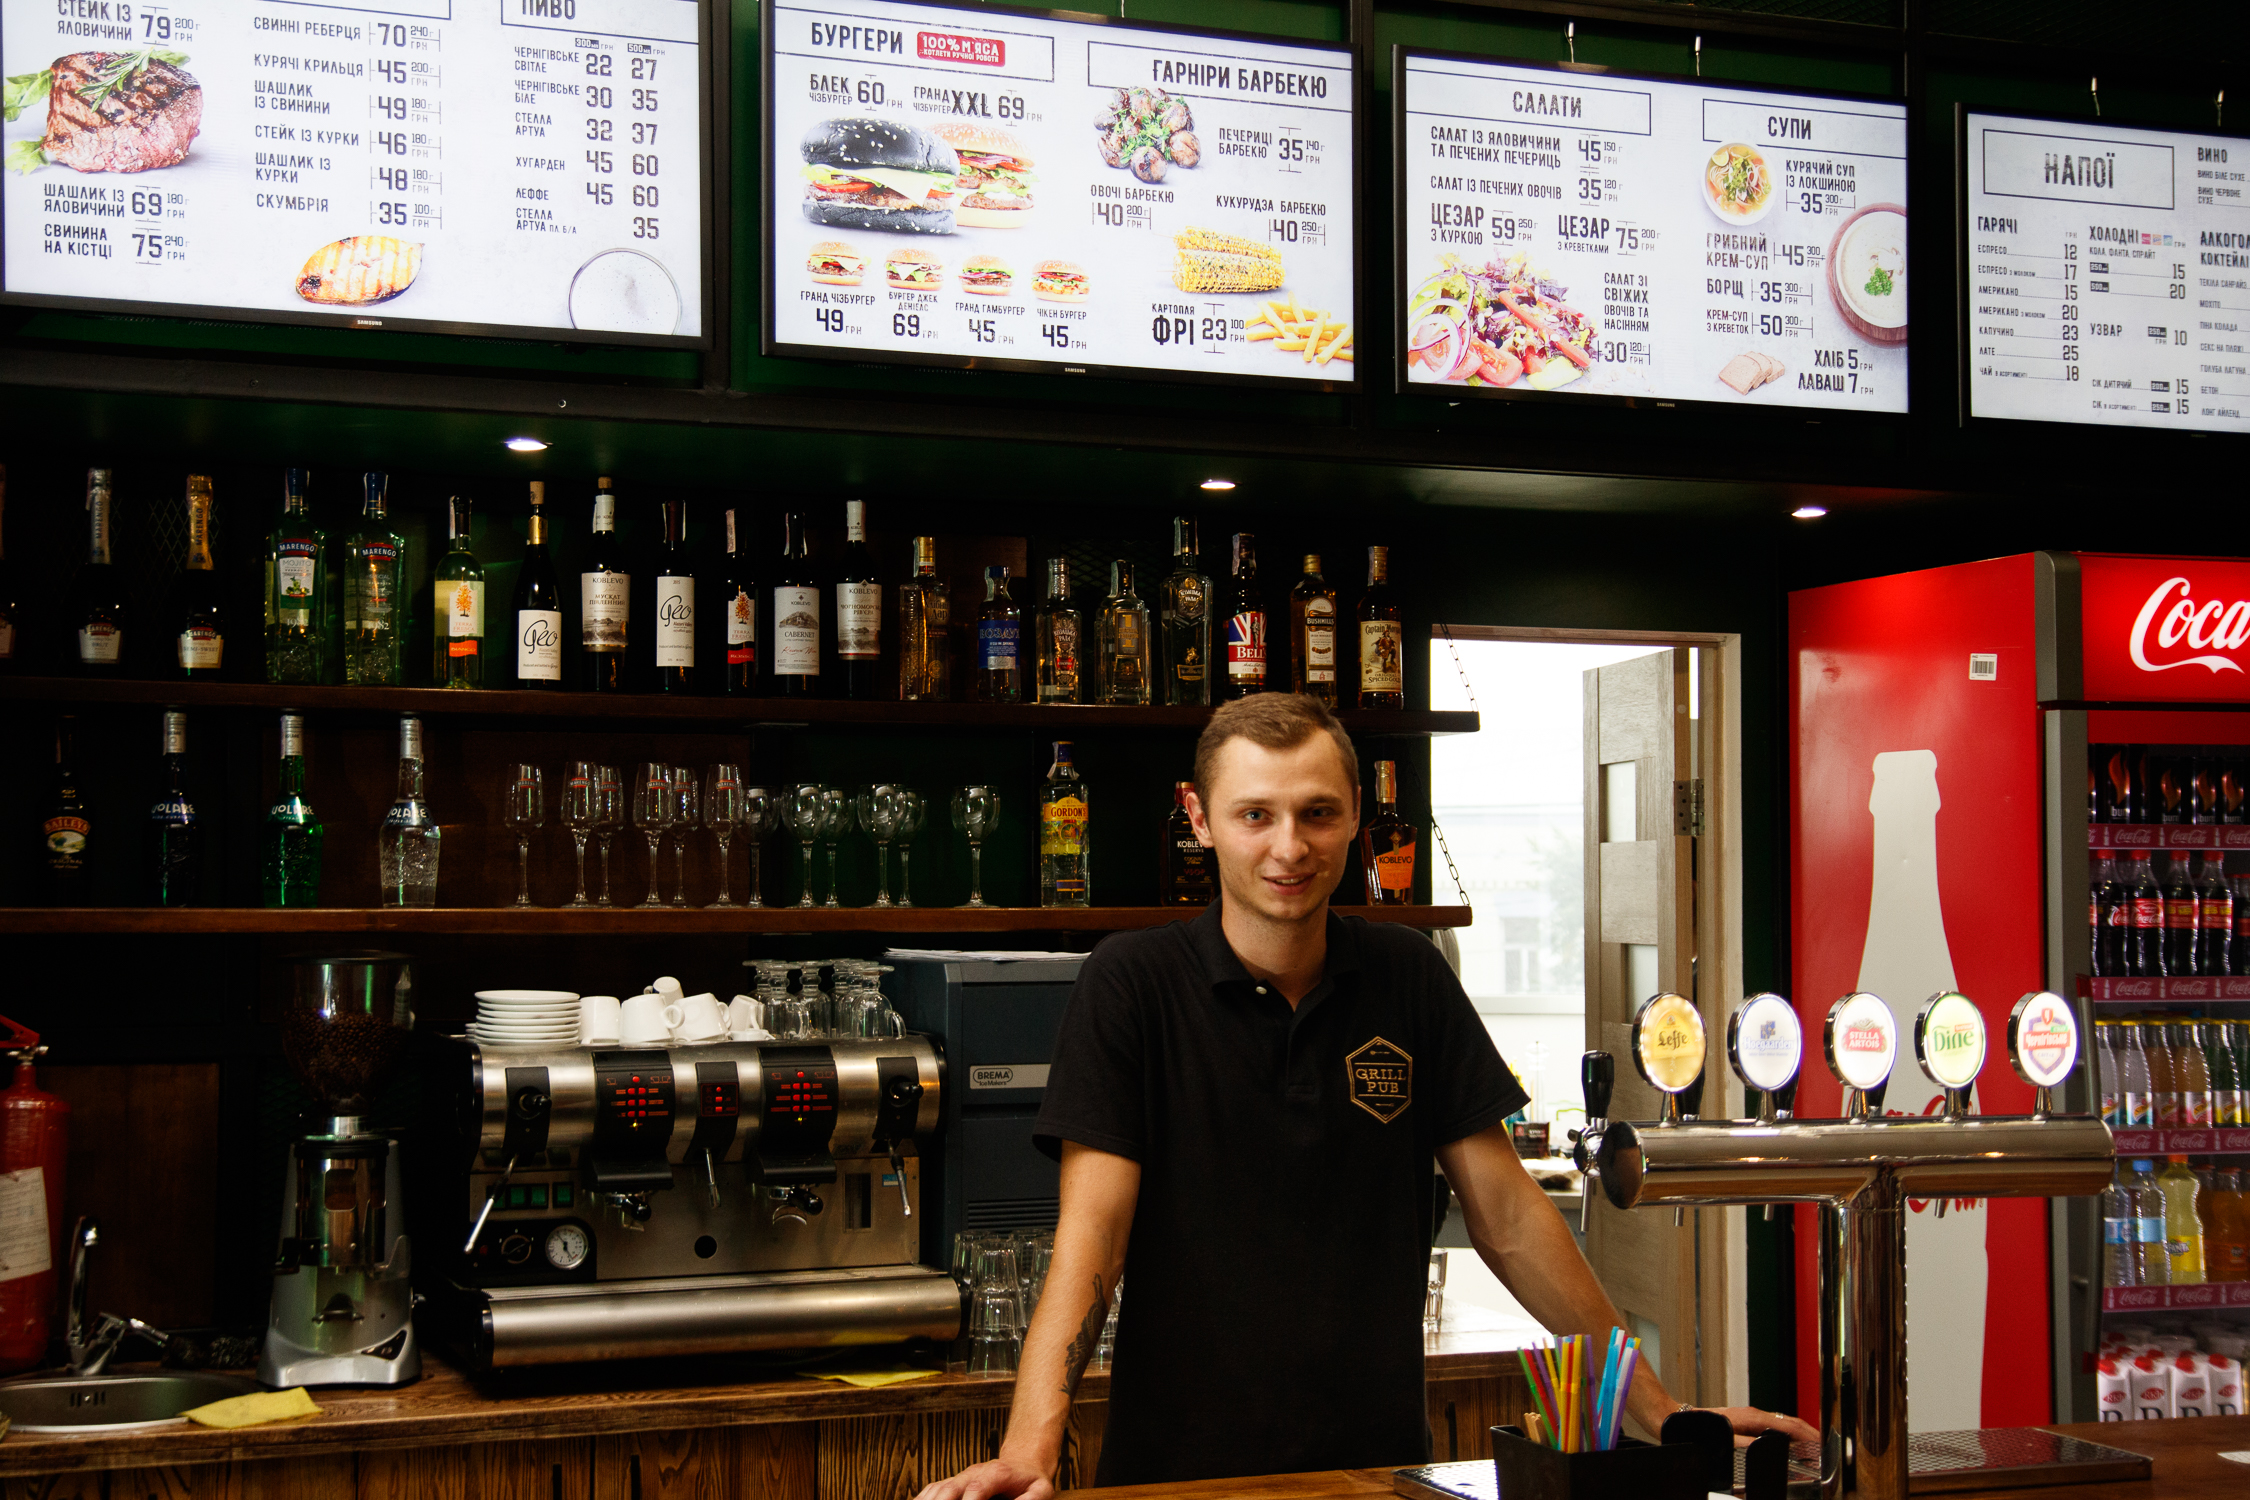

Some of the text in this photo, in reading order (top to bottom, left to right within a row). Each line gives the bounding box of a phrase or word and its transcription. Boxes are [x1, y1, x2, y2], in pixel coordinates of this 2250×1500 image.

[116, 3, 131, 22] ІЗ
[58, 20, 132, 41] ЯЛОВИЧИНИ
[140, 14, 171, 39] 79
[254, 17, 361, 40] СВИННІ РЕБЕРЦЯ
[378, 23, 406, 47] 70
[175, 32, 193, 42] ГРН
[810, 22, 903, 55] БУРГЕРИ
[922, 35, 960, 52] 100%
[514, 46, 580, 63] ЧЕРНІГІВСЬКЕ
[254, 54, 364, 78] КУРЯЧІ КРИЛЬЦЯ
[378, 60, 406, 84] 45
[514, 60, 547, 73] СВІТЛЕ
[810, 74, 850, 95] БЛЕК
[1152, 59, 1328, 98] ГАРНІРИ БАРБЕКЮ
[858, 80, 885, 105] 60
[914, 86, 950, 104] ГРАНД
[998, 96, 1024, 120] 69
[1512, 91, 1582, 118] САЛАТИ
[255, 124, 359, 146] СТЕЙК ІЗ КУРКИ
[1218, 127, 1272, 146] ПЕЧЕРИЦІ
[1768, 116, 1812, 140] СУПИ
[1430, 126, 1561, 152] САЛАТ ІЗ ЯЛОВИЧИНИ
[1218, 142, 1267, 158] БАРБЕКЮ
[1278, 138, 1303, 162] 35
[1431, 143, 1561, 170] ТА ПЕЧЕНИХ ПЕЧЕРИЦЬ
[1578, 139, 1601, 162] 45
[2198, 147, 2228, 164] ВИНО
[516, 156, 566, 172] ХУГАРДЕН
[1786, 160, 1855, 178] КУРЯЧИЙ СУП
[2044, 152, 2116, 189] НАПОЇ
[44, 183, 125, 202] ШАШЛИК ІЗ
[1430, 175, 1562, 200] САЛАТ ІЗ ПЕЧЕНИХ ОВОЧІВ
[1578, 178, 1602, 200] 35
[1786, 175, 1856, 193] ІЗ ЛОКШИНОЮ
[256, 194, 328, 213] СКУМБРІЯ
[516, 188, 550, 201] ЛЕФФЕ
[1090, 184, 1174, 204] ОВОЧІ БАРБЕКЮ
[44, 199, 125, 218] ЯЛОВИЧИНИ
[132, 192, 162, 216] 69
[1216, 194, 1326, 216] КУКУРУДЗА БАРБЕКЮ
[1098, 202, 1124, 226] 40
[1432, 202, 1484, 228] ЦЕЗАР
[44, 224, 108, 241] СВИНИНА
[1274, 219, 1298, 243] 40
[1492, 218, 1515, 239] 59
[1558, 214, 1610, 240] ЦЕЗАР
[1978, 216, 2018, 234] ГАРЯЧІ
[1430, 228, 1483, 245] З КУРКОЮ
[1616, 227, 1638, 250] 75
[1706, 232, 1768, 252] ГРИБНИЙ
[2090, 226, 2139, 245] ХОЛОДНІ
[44, 240, 112, 260] НА КІСТЦІ
[132, 234, 163, 259] 75
[1558, 242, 1609, 254] З КРЕВЕТКАМИ
[1978, 244, 2008, 255] ЕСПРЕСО
[2064, 244, 2078, 260] 12
[1706, 252, 1768, 270] КРЕМ-СУП
[1604, 272, 1648, 287] САЛАТ ЗІ
[1706, 278, 1744, 298] БОРЩ
[800, 290, 828, 304] ГРАНД
[888, 290, 938, 303] БУРГЕР ДЖЕК
[1604, 288, 1649, 304] СВІЖИХ
[1978, 286, 2019, 296] АМЕРИКАНО
[955, 302, 1026, 316] ГРАНД ГАМБУРГЕР
[1036, 308, 1087, 320] ЧІКЕН БУРГЕР
[1152, 302, 1195, 316] КАРТОПЛЯ
[1604, 304, 1649, 318] ОВОЧІВ ТА
[816, 308, 844, 333] 49
[893, 313, 920, 337] 69
[1152, 314, 1195, 346] ФРІ
[1202, 317, 1227, 342] 23
[1604, 318, 1649, 332] НАСІННЯМ
[2090, 323, 2122, 336] УЗВАР
[1979, 326, 2014, 337] КАПУЧИНО
[1814, 350, 1844, 368] ХЛІБ
[1979, 346, 1996, 356] ЛАТЕ
[1064, 366, 1086, 374] SAMSUNG
[1798, 372, 1844, 393] ЛАВАШ
[279, 543, 316, 552] MARENGO
[362, 548, 396, 557] MARENGO
[660, 595, 692, 627] Geo
[524, 620, 558, 654] Geo
[1378, 856, 1412, 864] KOBLEVO
[1848, 1040, 1880, 1048] ARTOIS
[1849, 1032, 1880, 1040] STELLA
[978, 1071, 1010, 1080] BREMA
[1356, 1068, 1406, 1080] GRILL
[1366, 1082, 1398, 1092] PUB
